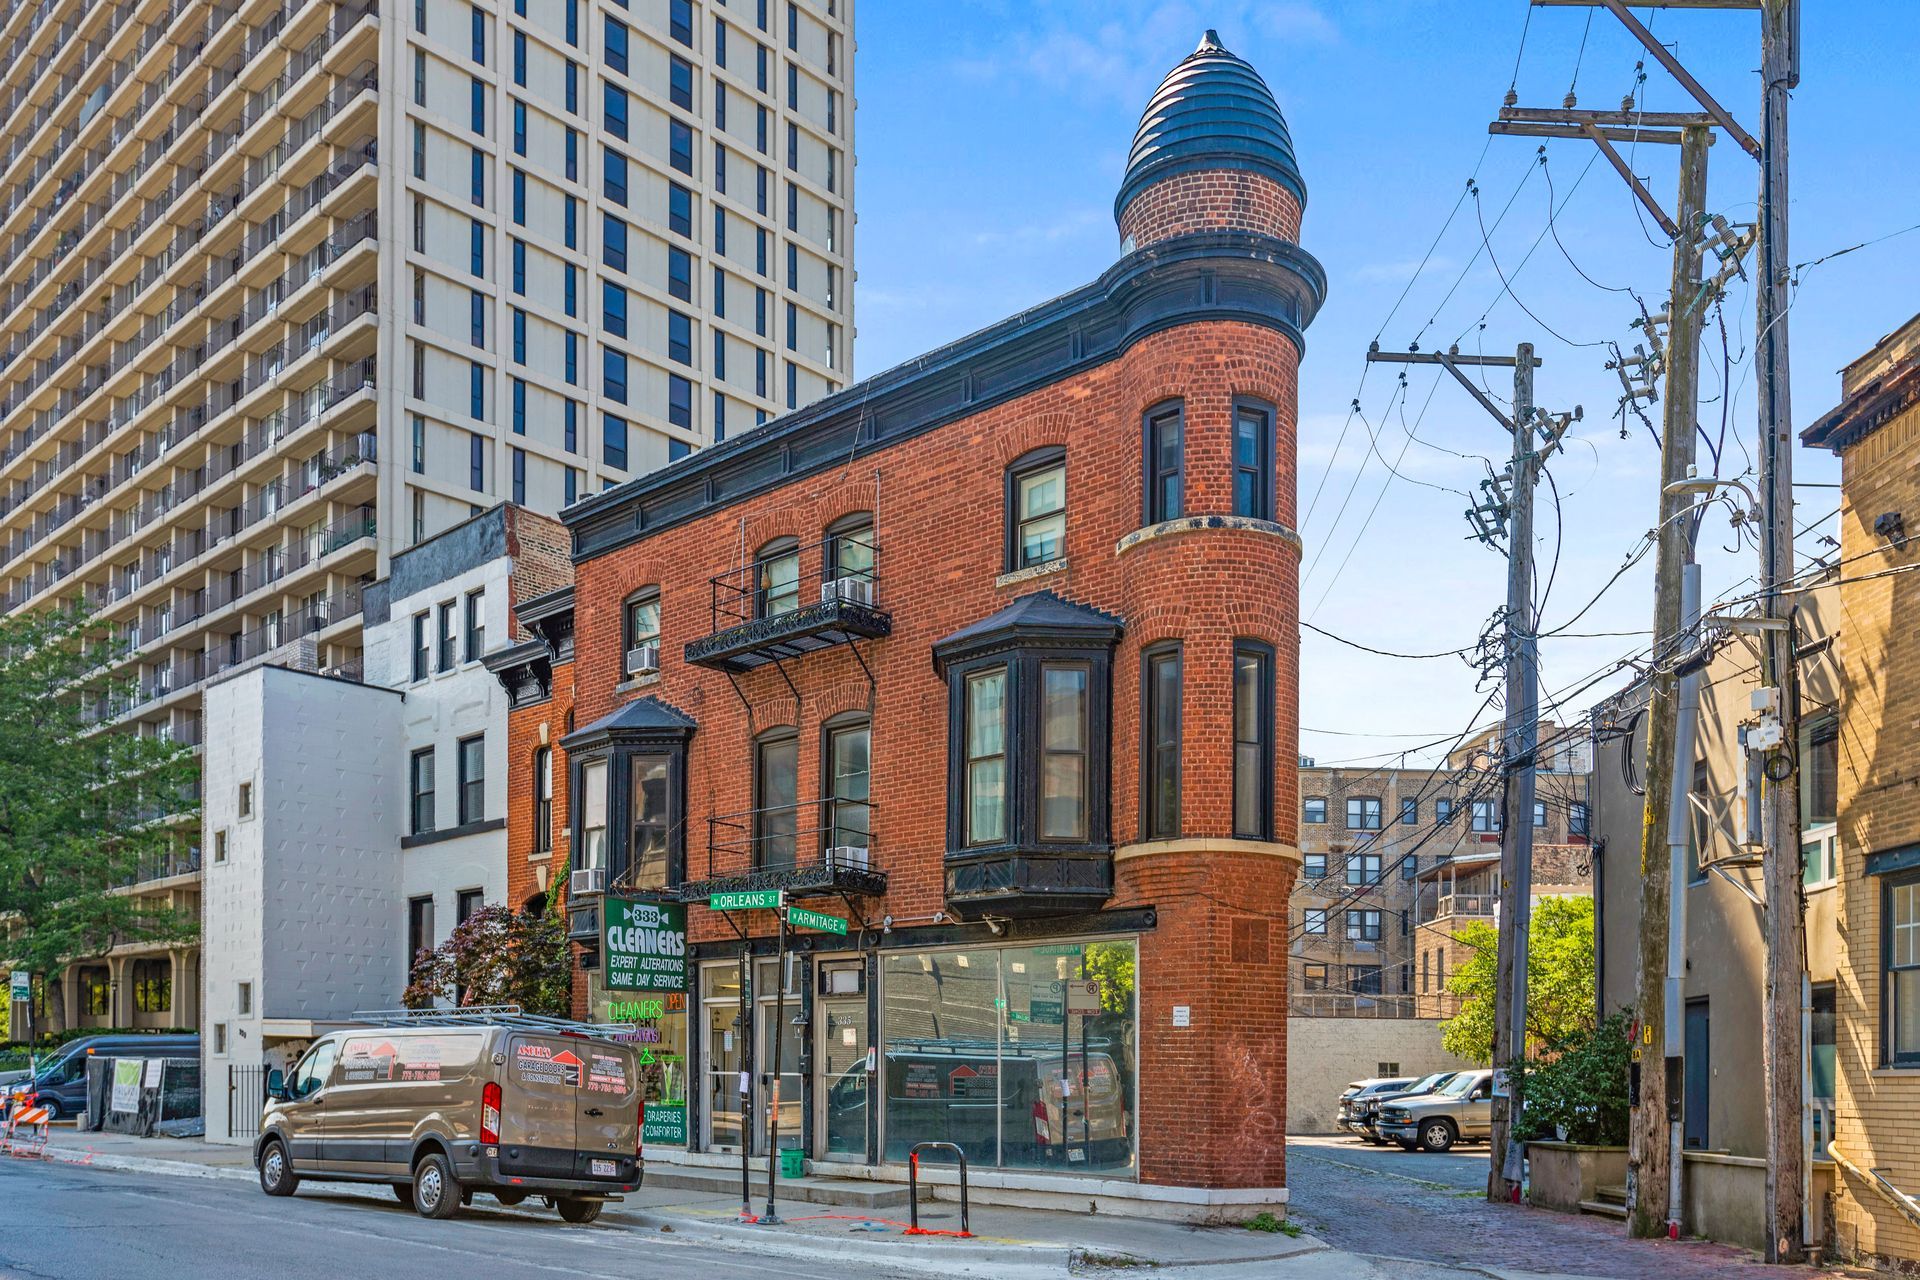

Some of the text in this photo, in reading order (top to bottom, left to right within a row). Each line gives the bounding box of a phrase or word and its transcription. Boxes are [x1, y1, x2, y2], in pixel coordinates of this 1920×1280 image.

[720, 893, 765, 908] ORLEANS
[768, 895, 776, 903] ST
[634, 909, 659, 923] 333
[797, 911, 838, 931] ARMITAGE
[607, 926, 685, 957] CLEANERS
[610, 955, 684, 972] EXPERT ALTERATIONS
[611, 971, 684, 988] SAME DAY SERVICE
[666, 993, 686, 1009] OPEN
[608, 1000, 663, 1020] CLEANERS
[517, 1060, 565, 1075] GARAGE DOORS
[646, 1110, 681, 1123] DRAPERIES
[645, 1125, 682, 1138] COMFORTER
